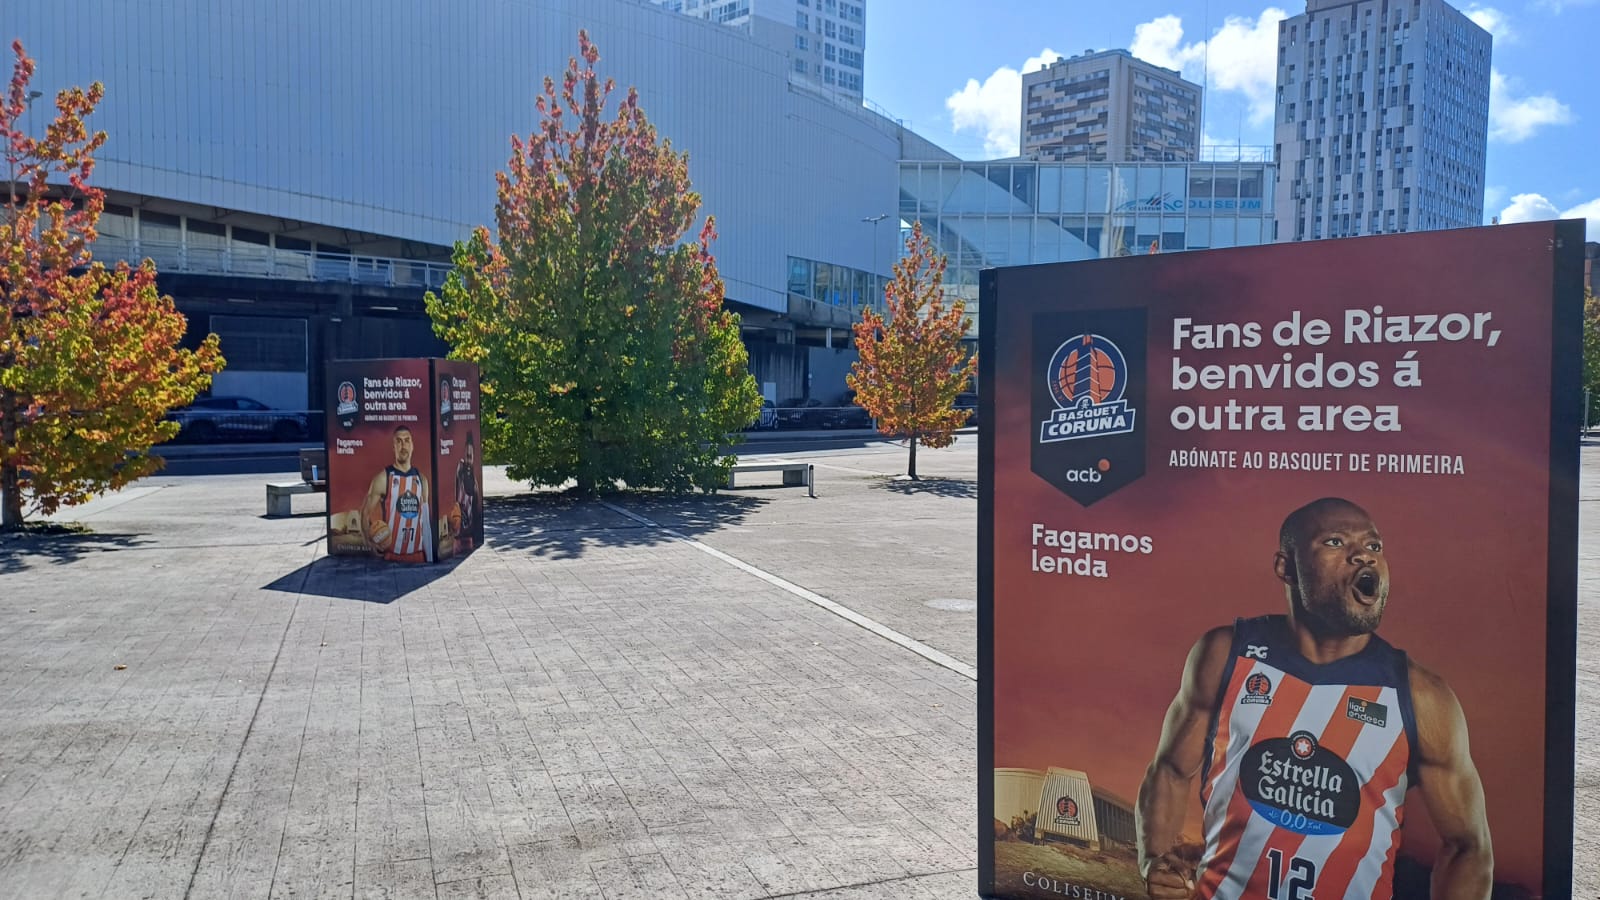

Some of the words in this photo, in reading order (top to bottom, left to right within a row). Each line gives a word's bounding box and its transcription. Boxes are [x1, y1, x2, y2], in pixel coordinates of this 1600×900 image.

[1173, 199, 1261, 209] COLISEUM
[1173, 317, 1262, 350] Fans
[1272, 310, 1331, 347] de
[1344, 305, 1502, 347] Riazor,
[1172, 352, 1379, 390] benvidos
[1393, 351, 1422, 387] á
[363, 377, 382, 387] Fans
[382, 377, 394, 387] de
[395, 377, 423, 389] Riazor,
[363, 388, 403, 399] benvidos
[404, 388, 410, 399] á
[364, 401, 387, 411] outra
[388, 402, 407, 411] area
[1058, 405, 1119, 422] BASQUET
[1170, 399, 1286, 431] outra
[1297, 404, 1402, 432] area
[1048, 415, 1126, 436] CORUÑA
[1169, 447, 1237, 469] ABÓNATE
[1242, 451, 1263, 470] AO
[1268, 452, 1343, 472] BASQUET
[1350, 454, 1371, 472] DE
[1376, 455, 1465, 475] PRIMEIRA
[1066, 467, 1102, 483] acb
[1032, 523, 1153, 554] Fagamos
[1032, 548, 1108, 578] lenda
[1349, 701, 1366, 713] liga
[1348, 711, 1385, 727] endesa
[1258, 750, 1342, 793] Estrella
[1258, 775, 1336, 819] Galicia
[1280, 808, 1307, 830] 0,0
[1266, 847, 1316, 900] 12
